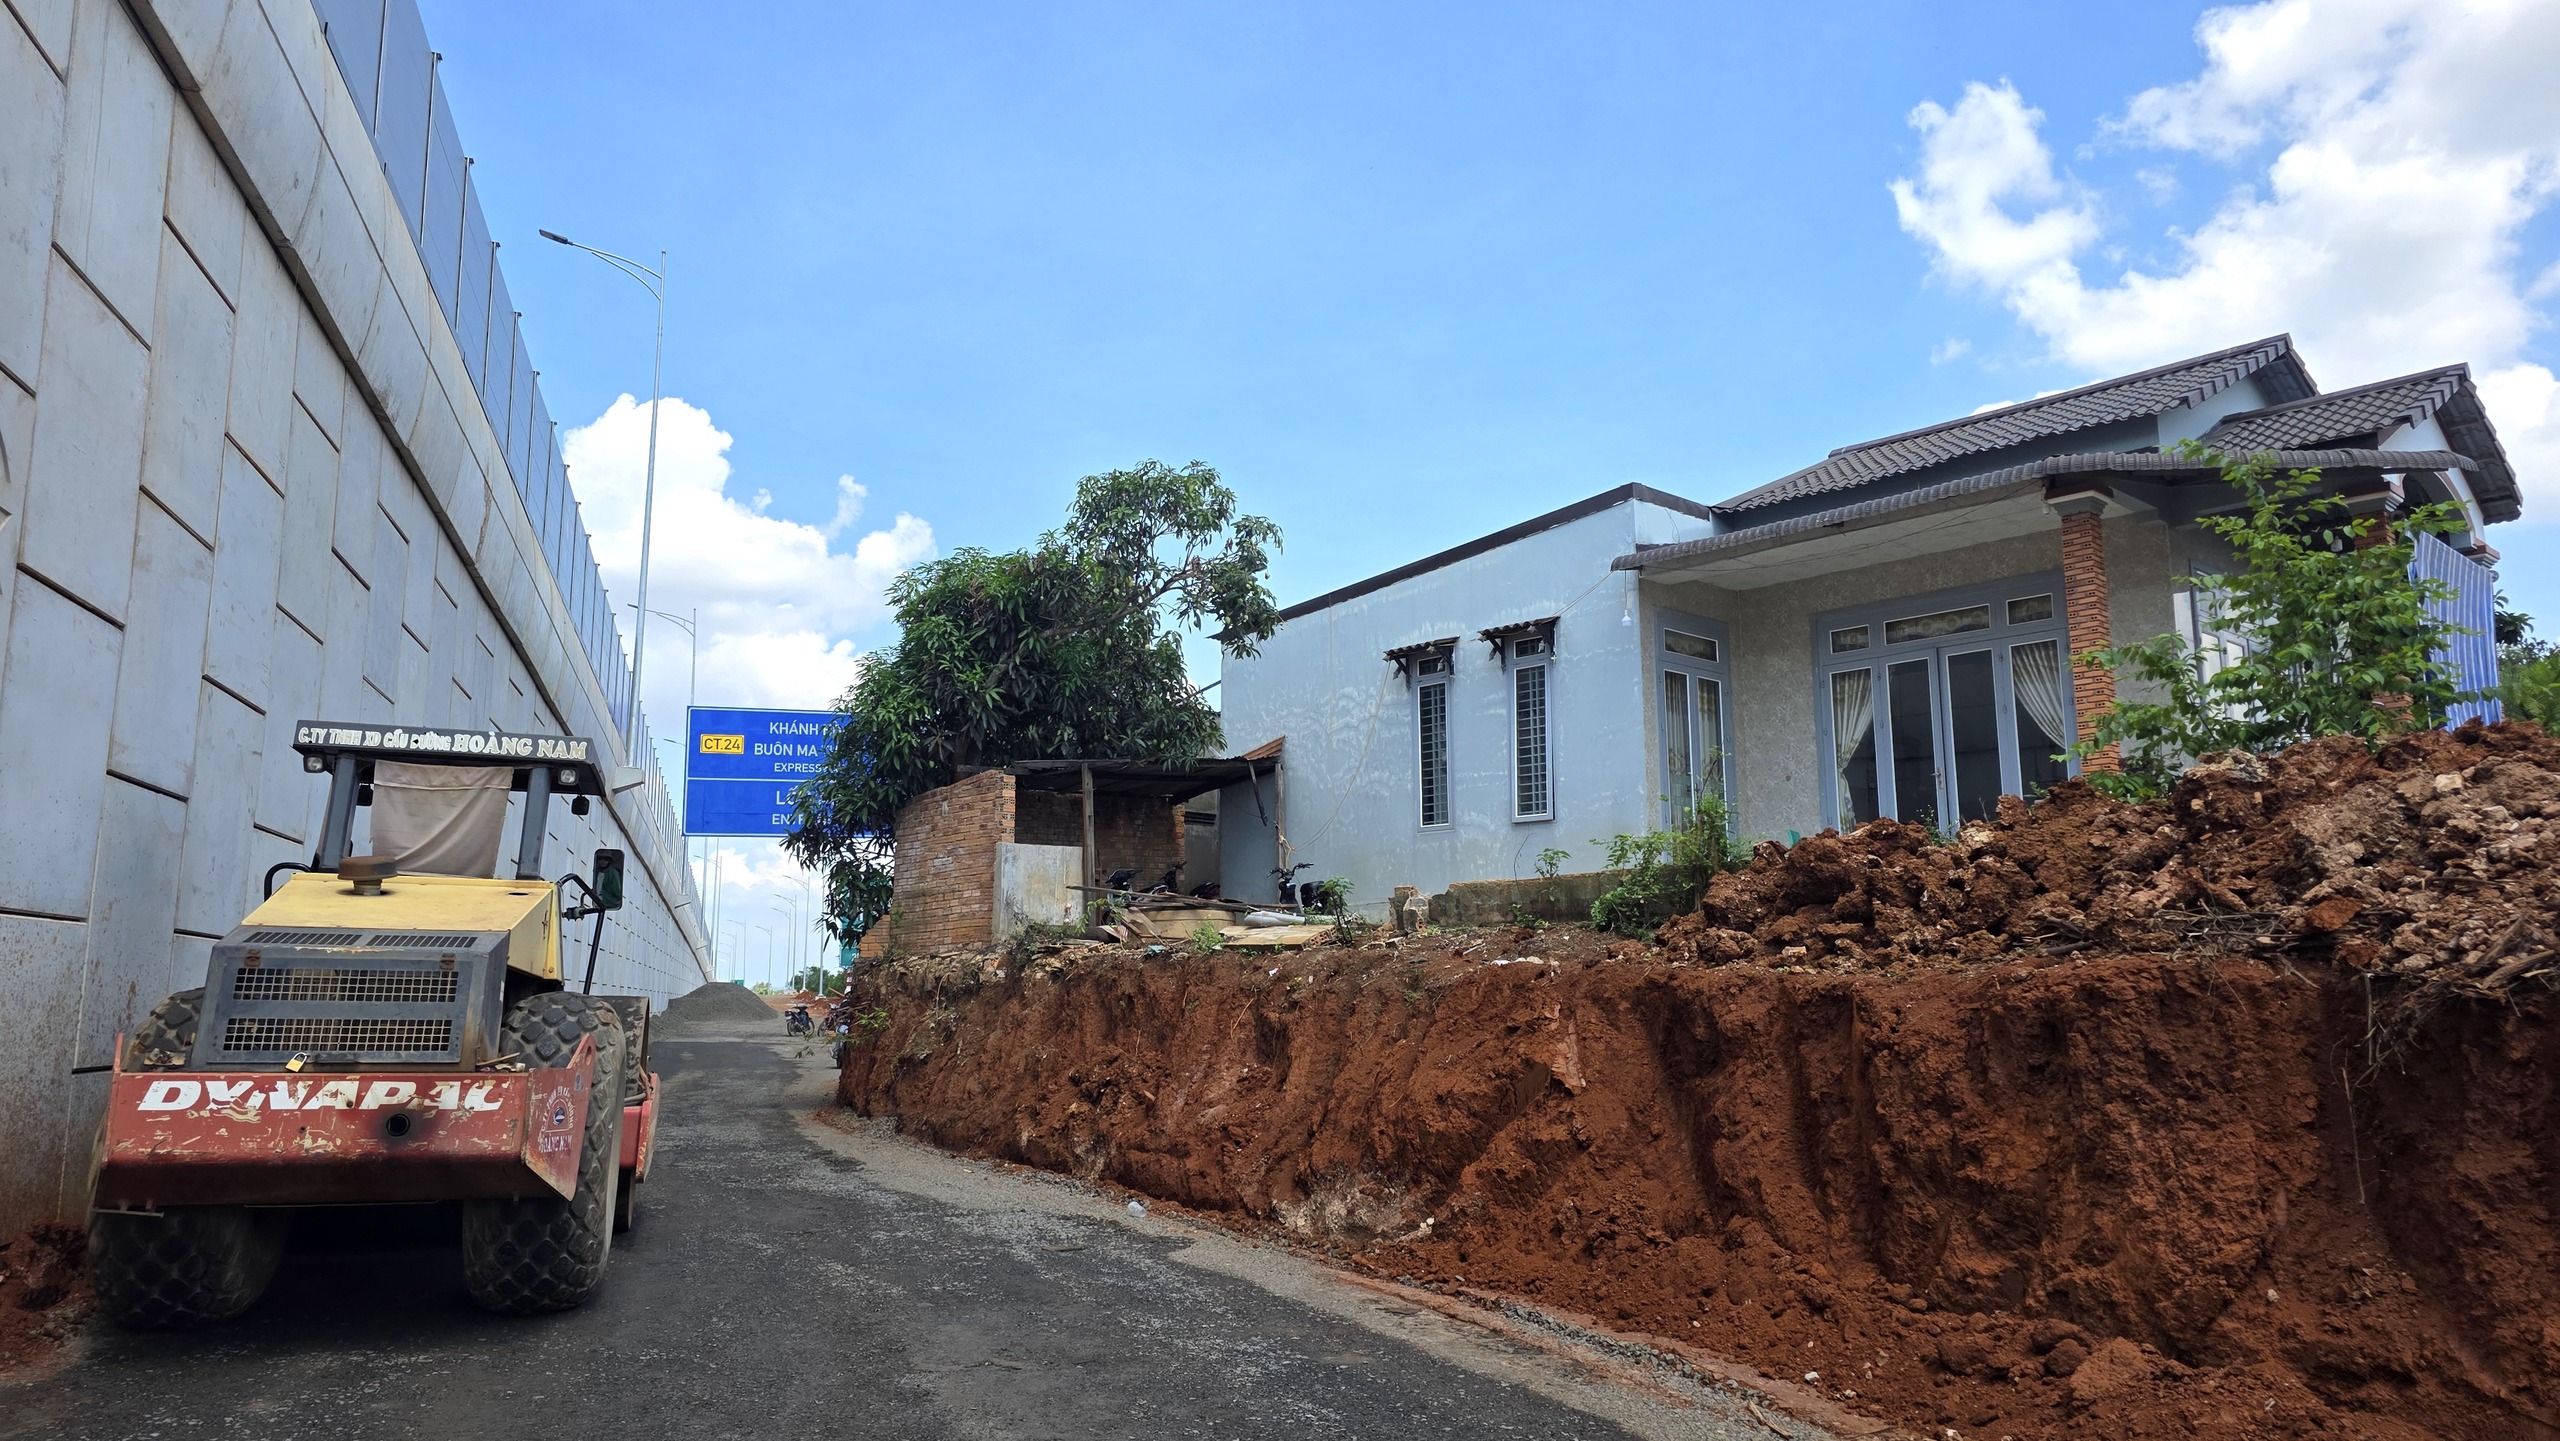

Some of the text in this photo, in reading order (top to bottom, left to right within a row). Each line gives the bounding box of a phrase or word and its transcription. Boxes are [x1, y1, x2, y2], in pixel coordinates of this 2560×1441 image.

[769, 719, 819, 735] KHÁNH
[329, 728, 362, 745] TNHH
[363, 731, 382, 746] XD
[452, 731, 533, 756] HOÀNG
[536, 739, 588, 760] NAM
[704, 738, 741, 750] CT.24
[754, 741, 793, 756] BUÔN
[797, 744, 818, 757] MA
